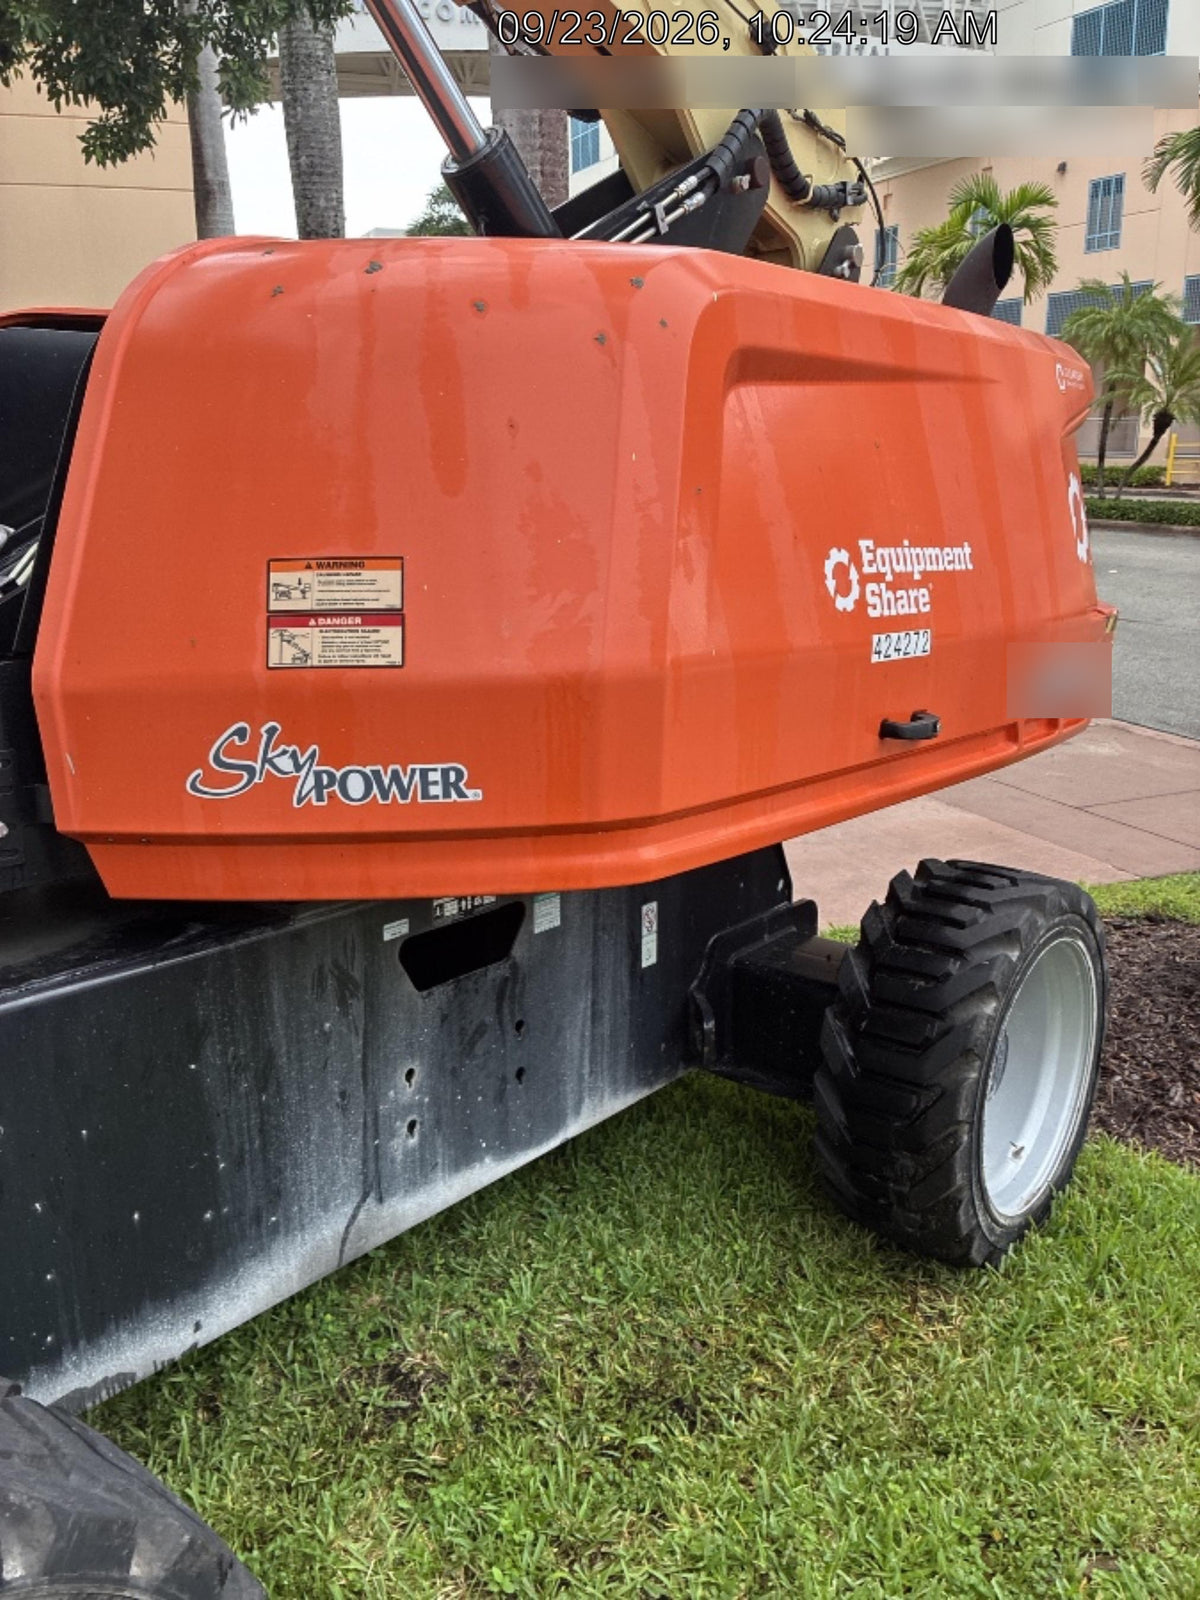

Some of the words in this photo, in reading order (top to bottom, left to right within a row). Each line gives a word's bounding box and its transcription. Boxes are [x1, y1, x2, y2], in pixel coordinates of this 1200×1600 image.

[316, 561, 365, 569] WARNING
[858, 539, 973, 581] Equipment
[866, 582, 930, 618] Share
[318, 617, 361, 625] DANGER
[873, 630, 930, 660] 424272
